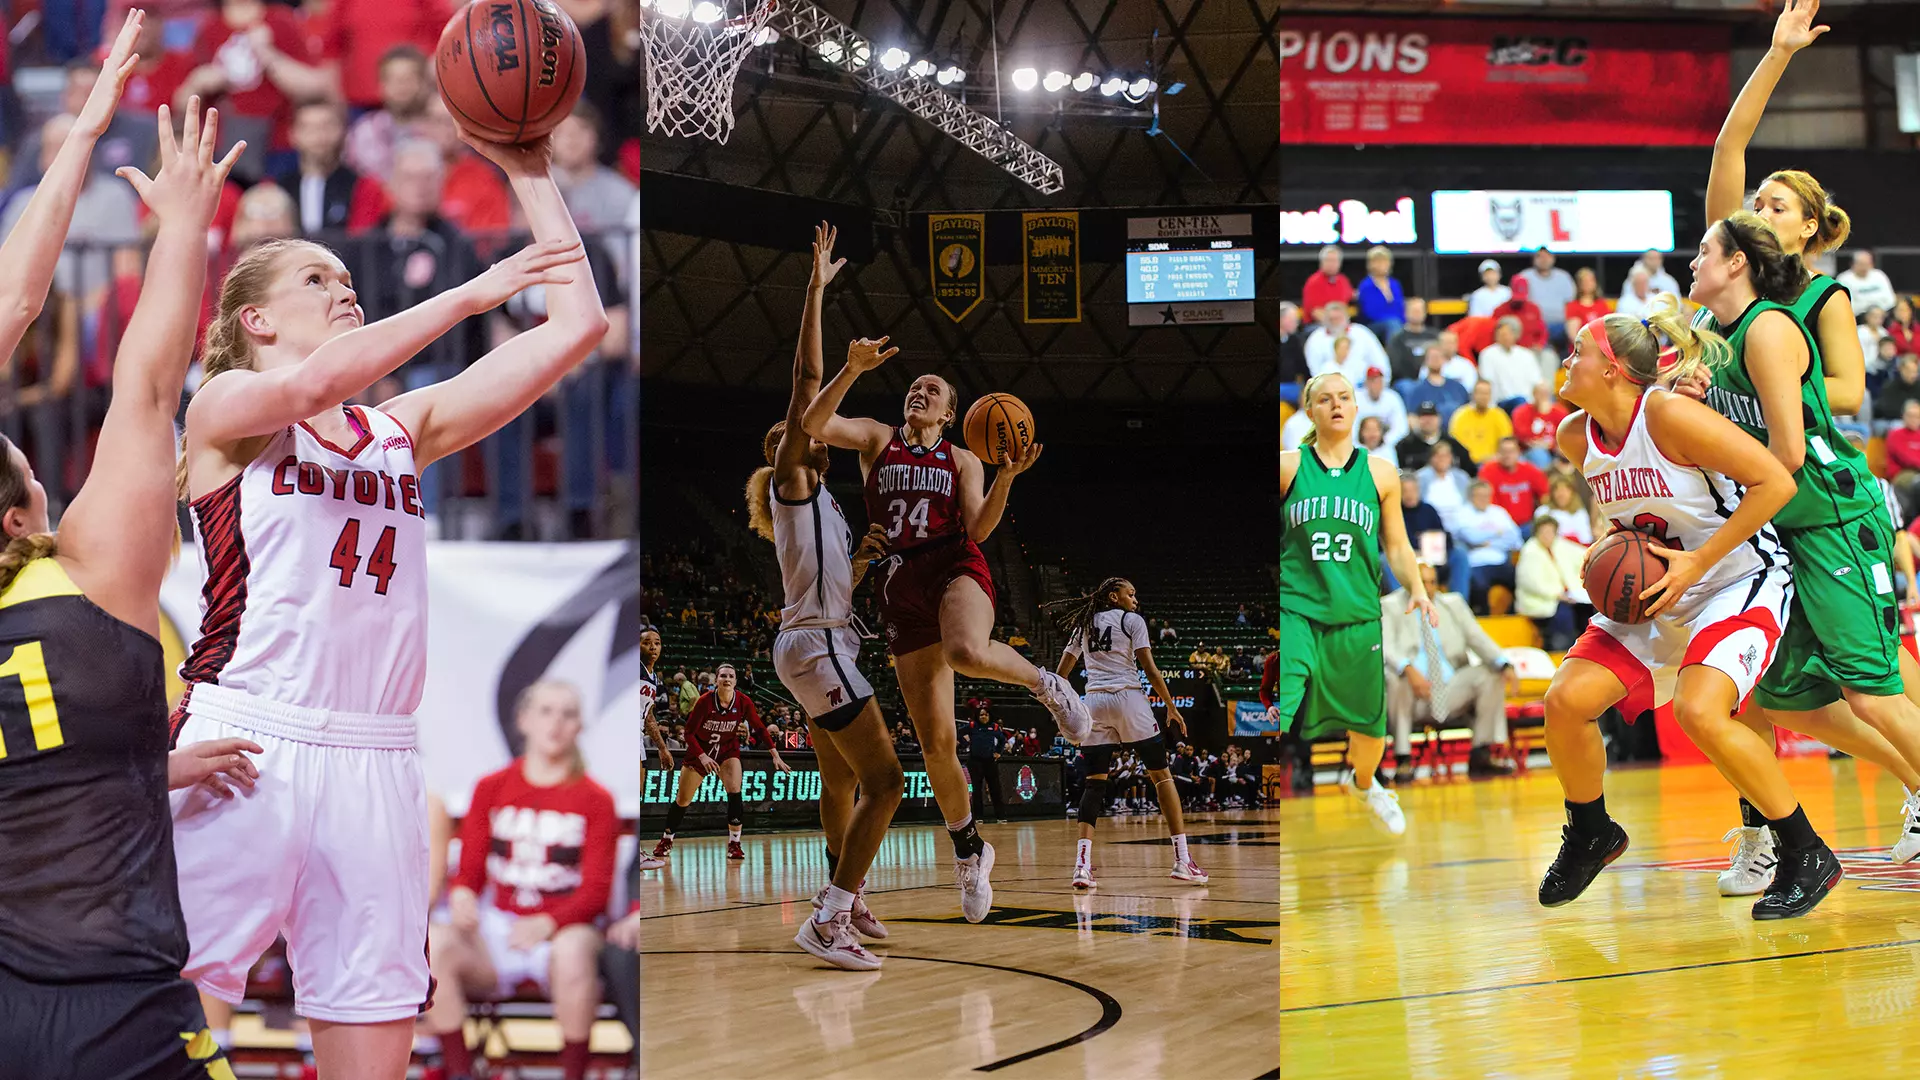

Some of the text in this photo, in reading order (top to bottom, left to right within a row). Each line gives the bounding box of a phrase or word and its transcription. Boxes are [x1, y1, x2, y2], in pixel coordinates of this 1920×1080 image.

[491, 4, 519, 73] NCAA
[1280, 31, 1429, 73] PIONS
[933, 219, 981, 231] BAYLOR
[1027, 217, 1076, 231] BAYLOR
[1157, 216, 1220, 229] CEN-TEX
[1183, 228, 1223, 236] SYSTEMS
[1210, 241, 1233, 249] MISS
[1038, 273, 1067, 285] TEN
[1144, 282, 1155, 291] 27
[1228, 289, 1237, 298] 11
[1182, 309, 1224, 318] GRANDE
[878, 464, 953, 497] SOUTH DAKOTA
[1614, 467, 1674, 501] DAKOTA
[887, 497, 931, 540] 34
[1290, 495, 1374, 537] NORTH DAKOTA
[1311, 531, 1353, 562] 23
[329, 517, 397, 596] 44
[1184, 670, 1194, 679] 61
[0, 640, 65, 760] 1
[708, 733, 721, 744] 2
[771, 770, 822, 801] STUD
